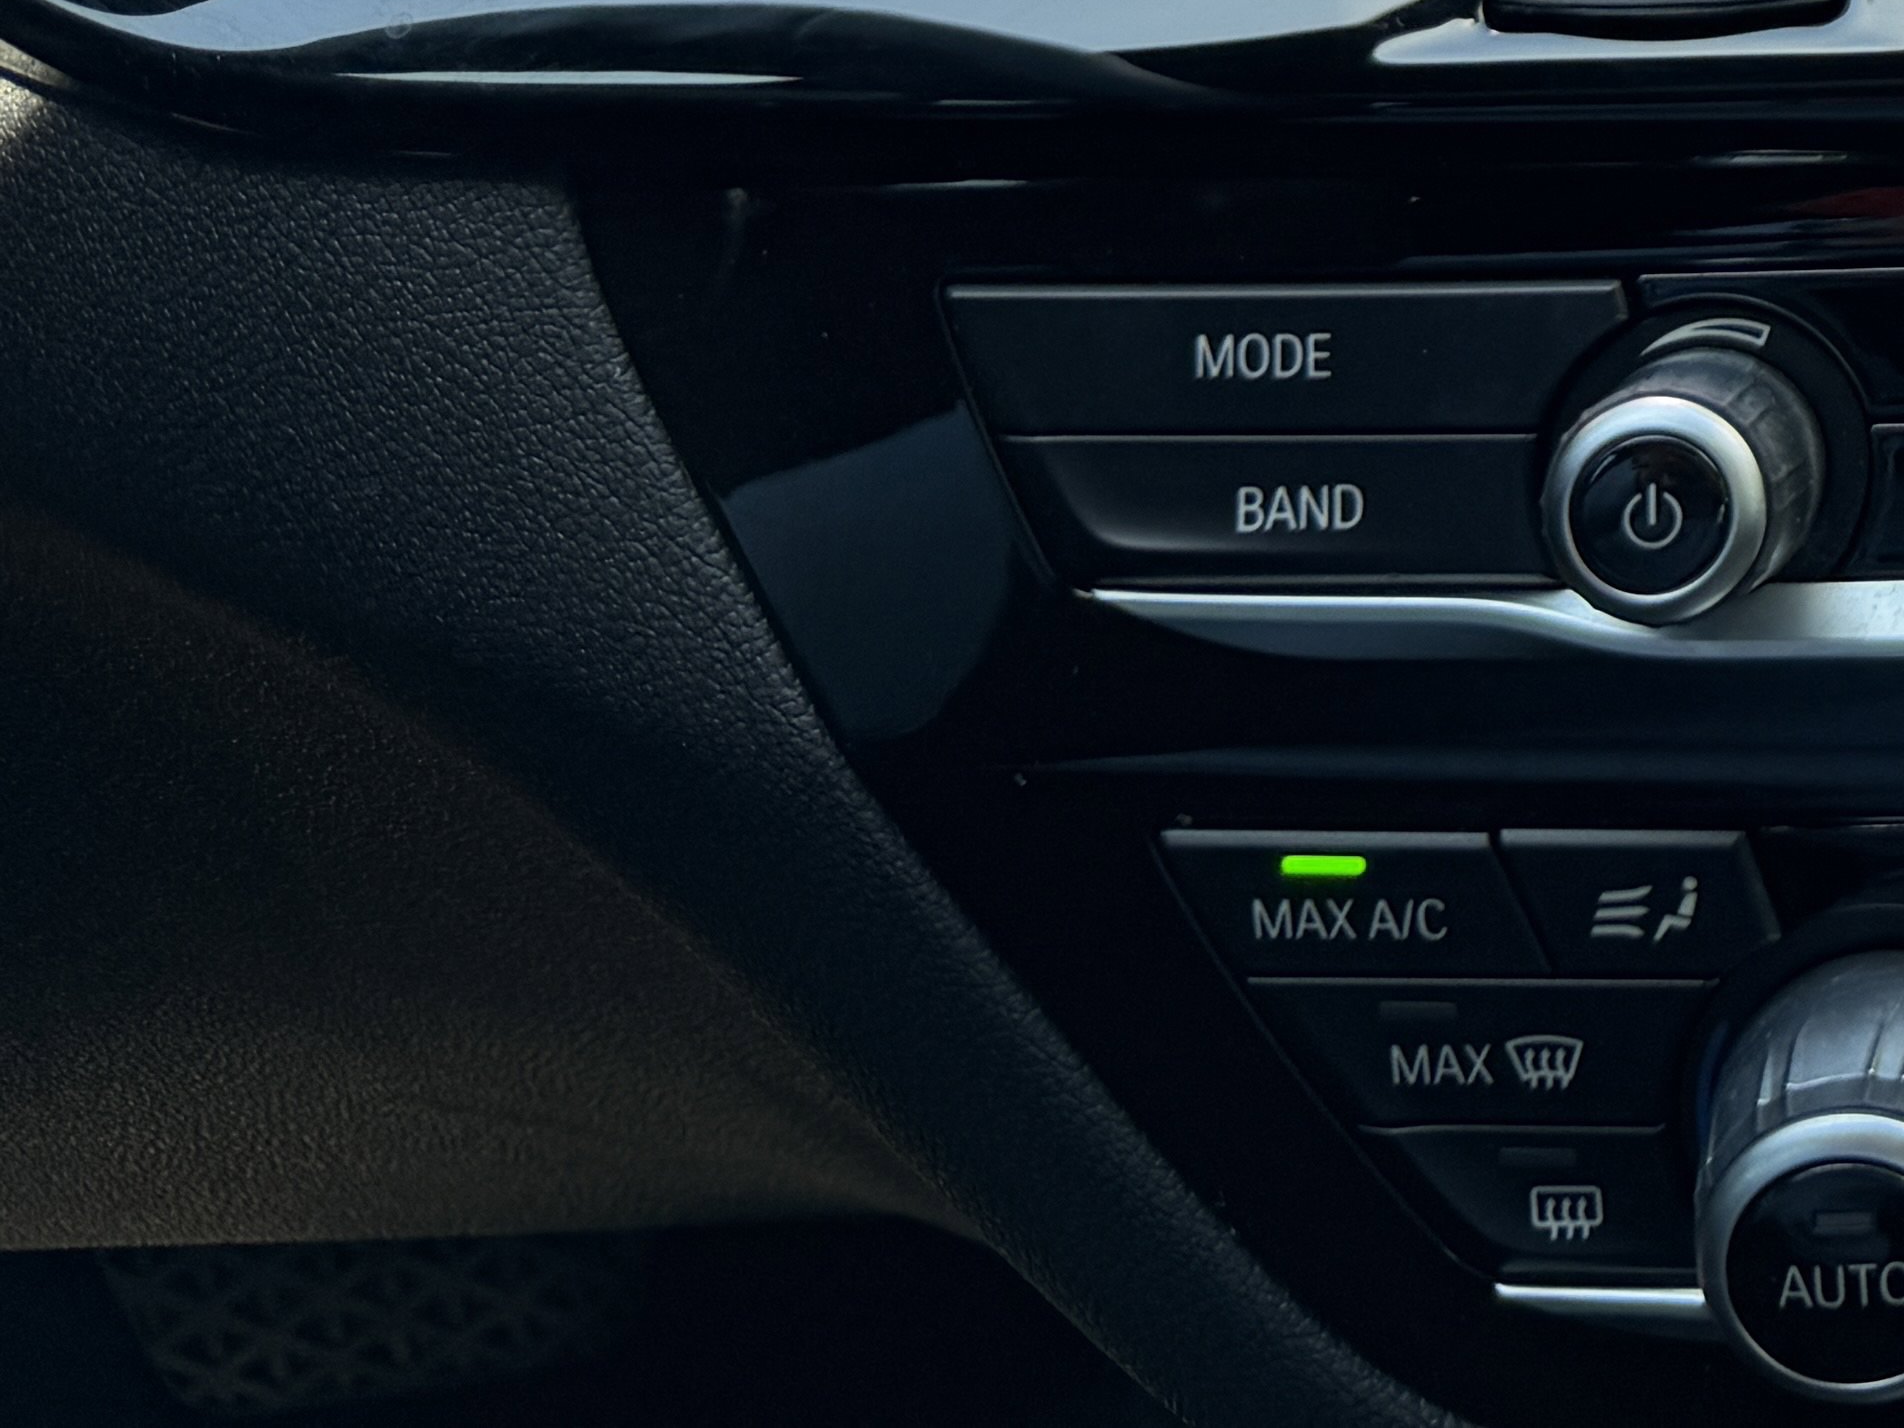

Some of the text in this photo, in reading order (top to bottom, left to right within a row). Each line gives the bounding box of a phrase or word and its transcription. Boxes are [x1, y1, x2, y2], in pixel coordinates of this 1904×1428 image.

[1195, 332, 1333, 382] MODE
[1234, 483, 1365, 533] BAND
[1252, 898, 1448, 941] MAX A/C
[1389, 1045, 1494, 1087] MAX
